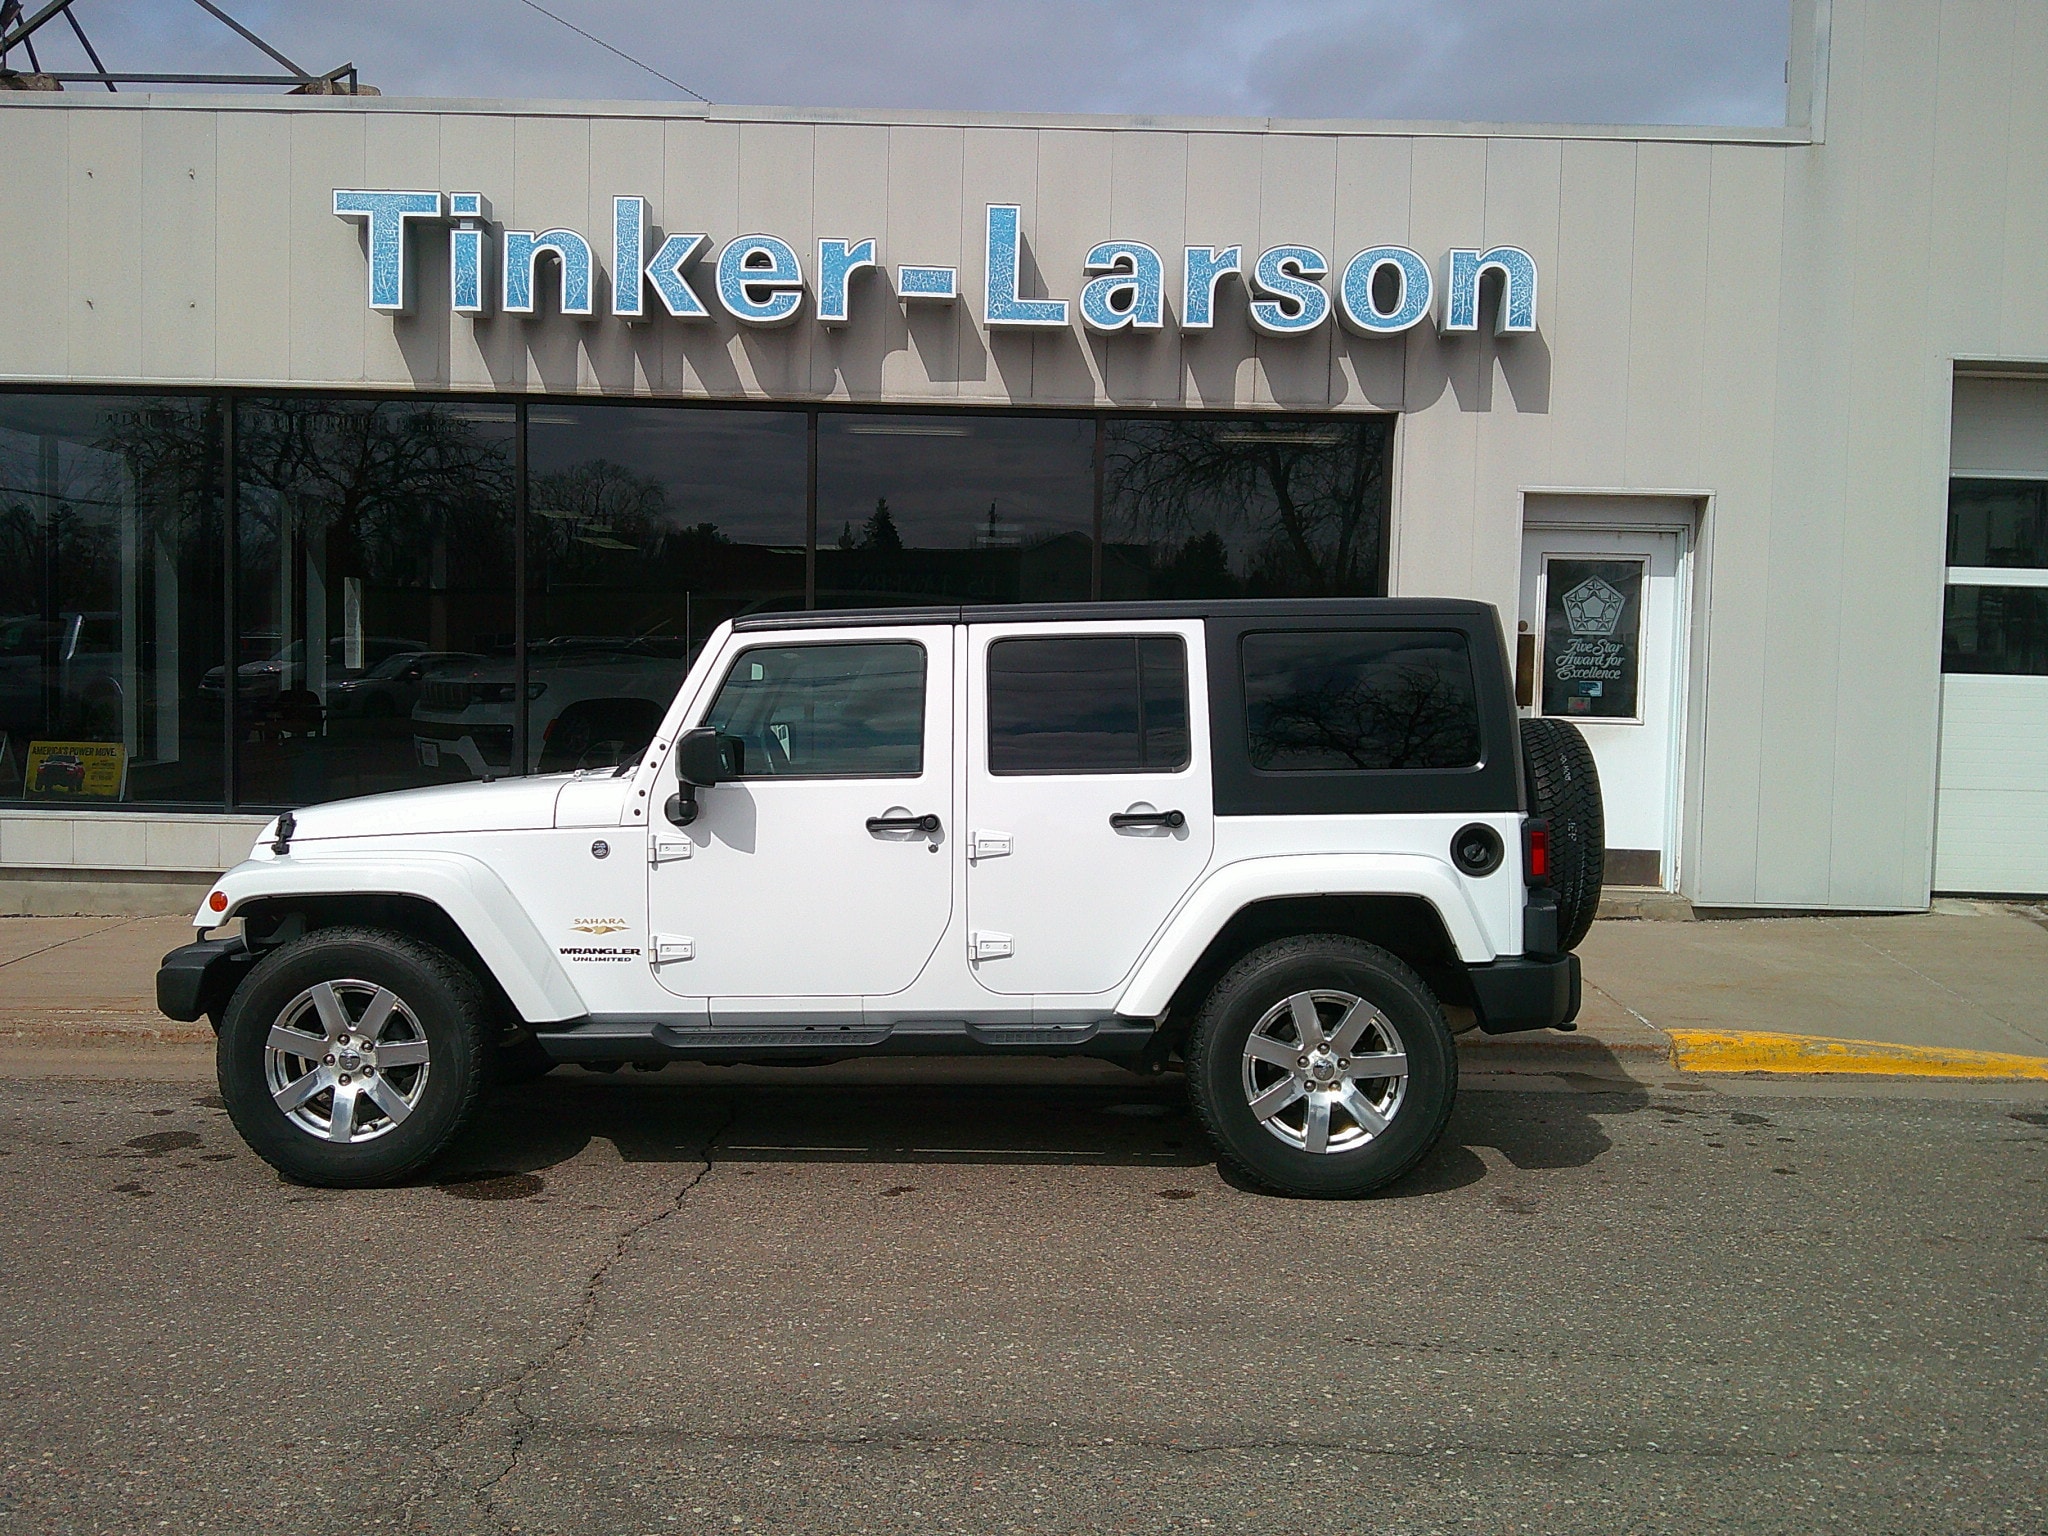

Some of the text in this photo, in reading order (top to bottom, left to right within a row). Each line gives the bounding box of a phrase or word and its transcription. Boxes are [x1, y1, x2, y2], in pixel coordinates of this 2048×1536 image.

[332, 188, 1539, 335] Tinker-Larson
[1563, 638, 1624, 654] Five Star
[1555, 652, 1626, 668] Award for
[1555, 664, 1622, 681] Excellence
[32, 746, 69, 756] AMERICA'S
[70, 746, 95, 756] POWER
[559, 947, 642, 956] WRANGLER
